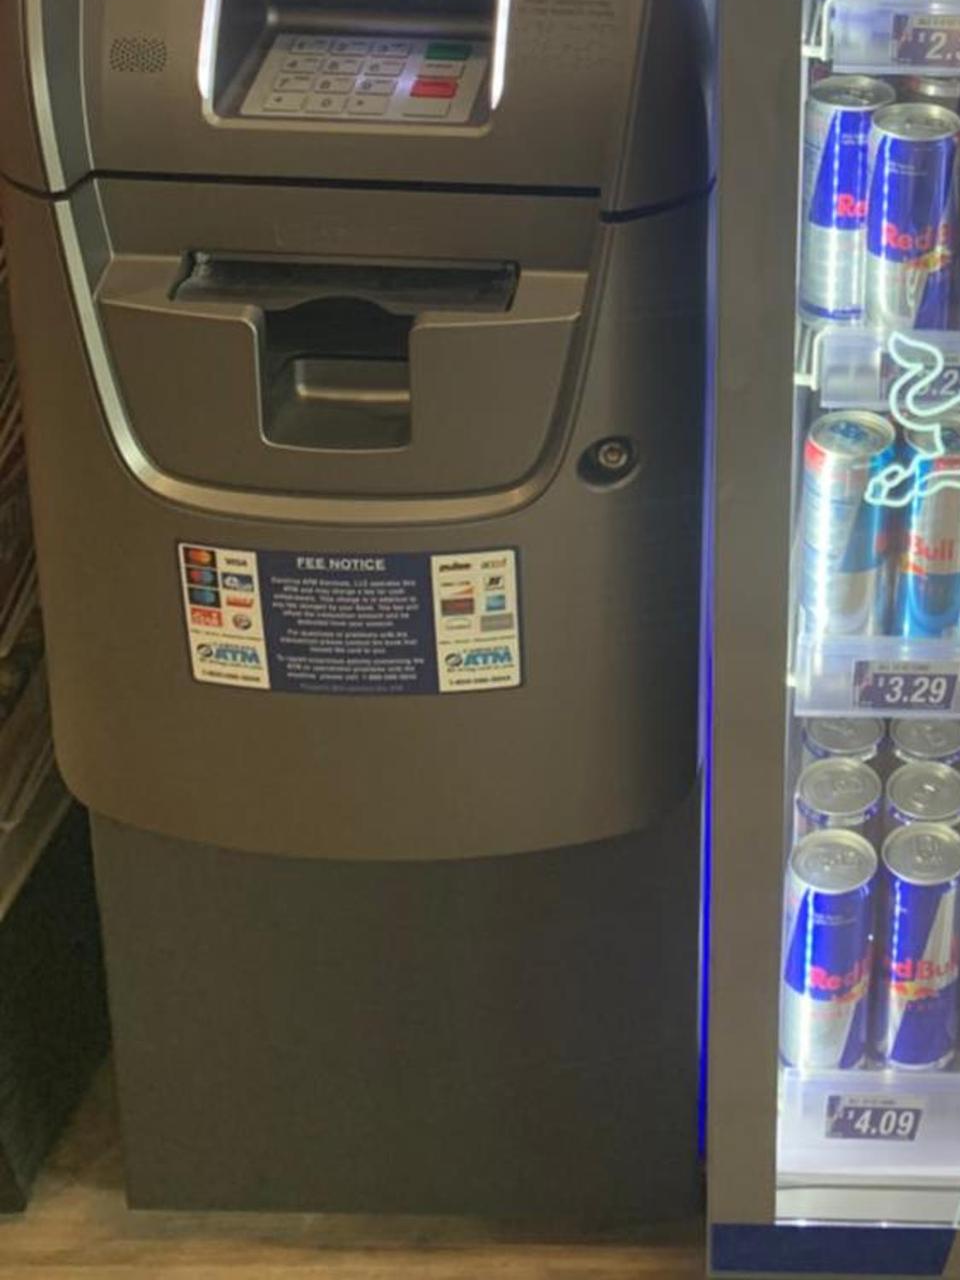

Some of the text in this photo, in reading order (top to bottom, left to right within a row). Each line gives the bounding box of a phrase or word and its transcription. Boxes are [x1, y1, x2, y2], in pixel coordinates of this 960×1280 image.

[296, 557, 386, 571] FEE NOTICE
[878, 676, 947, 705] $3.29
[847, 1110, 914, 1136] $4.09
